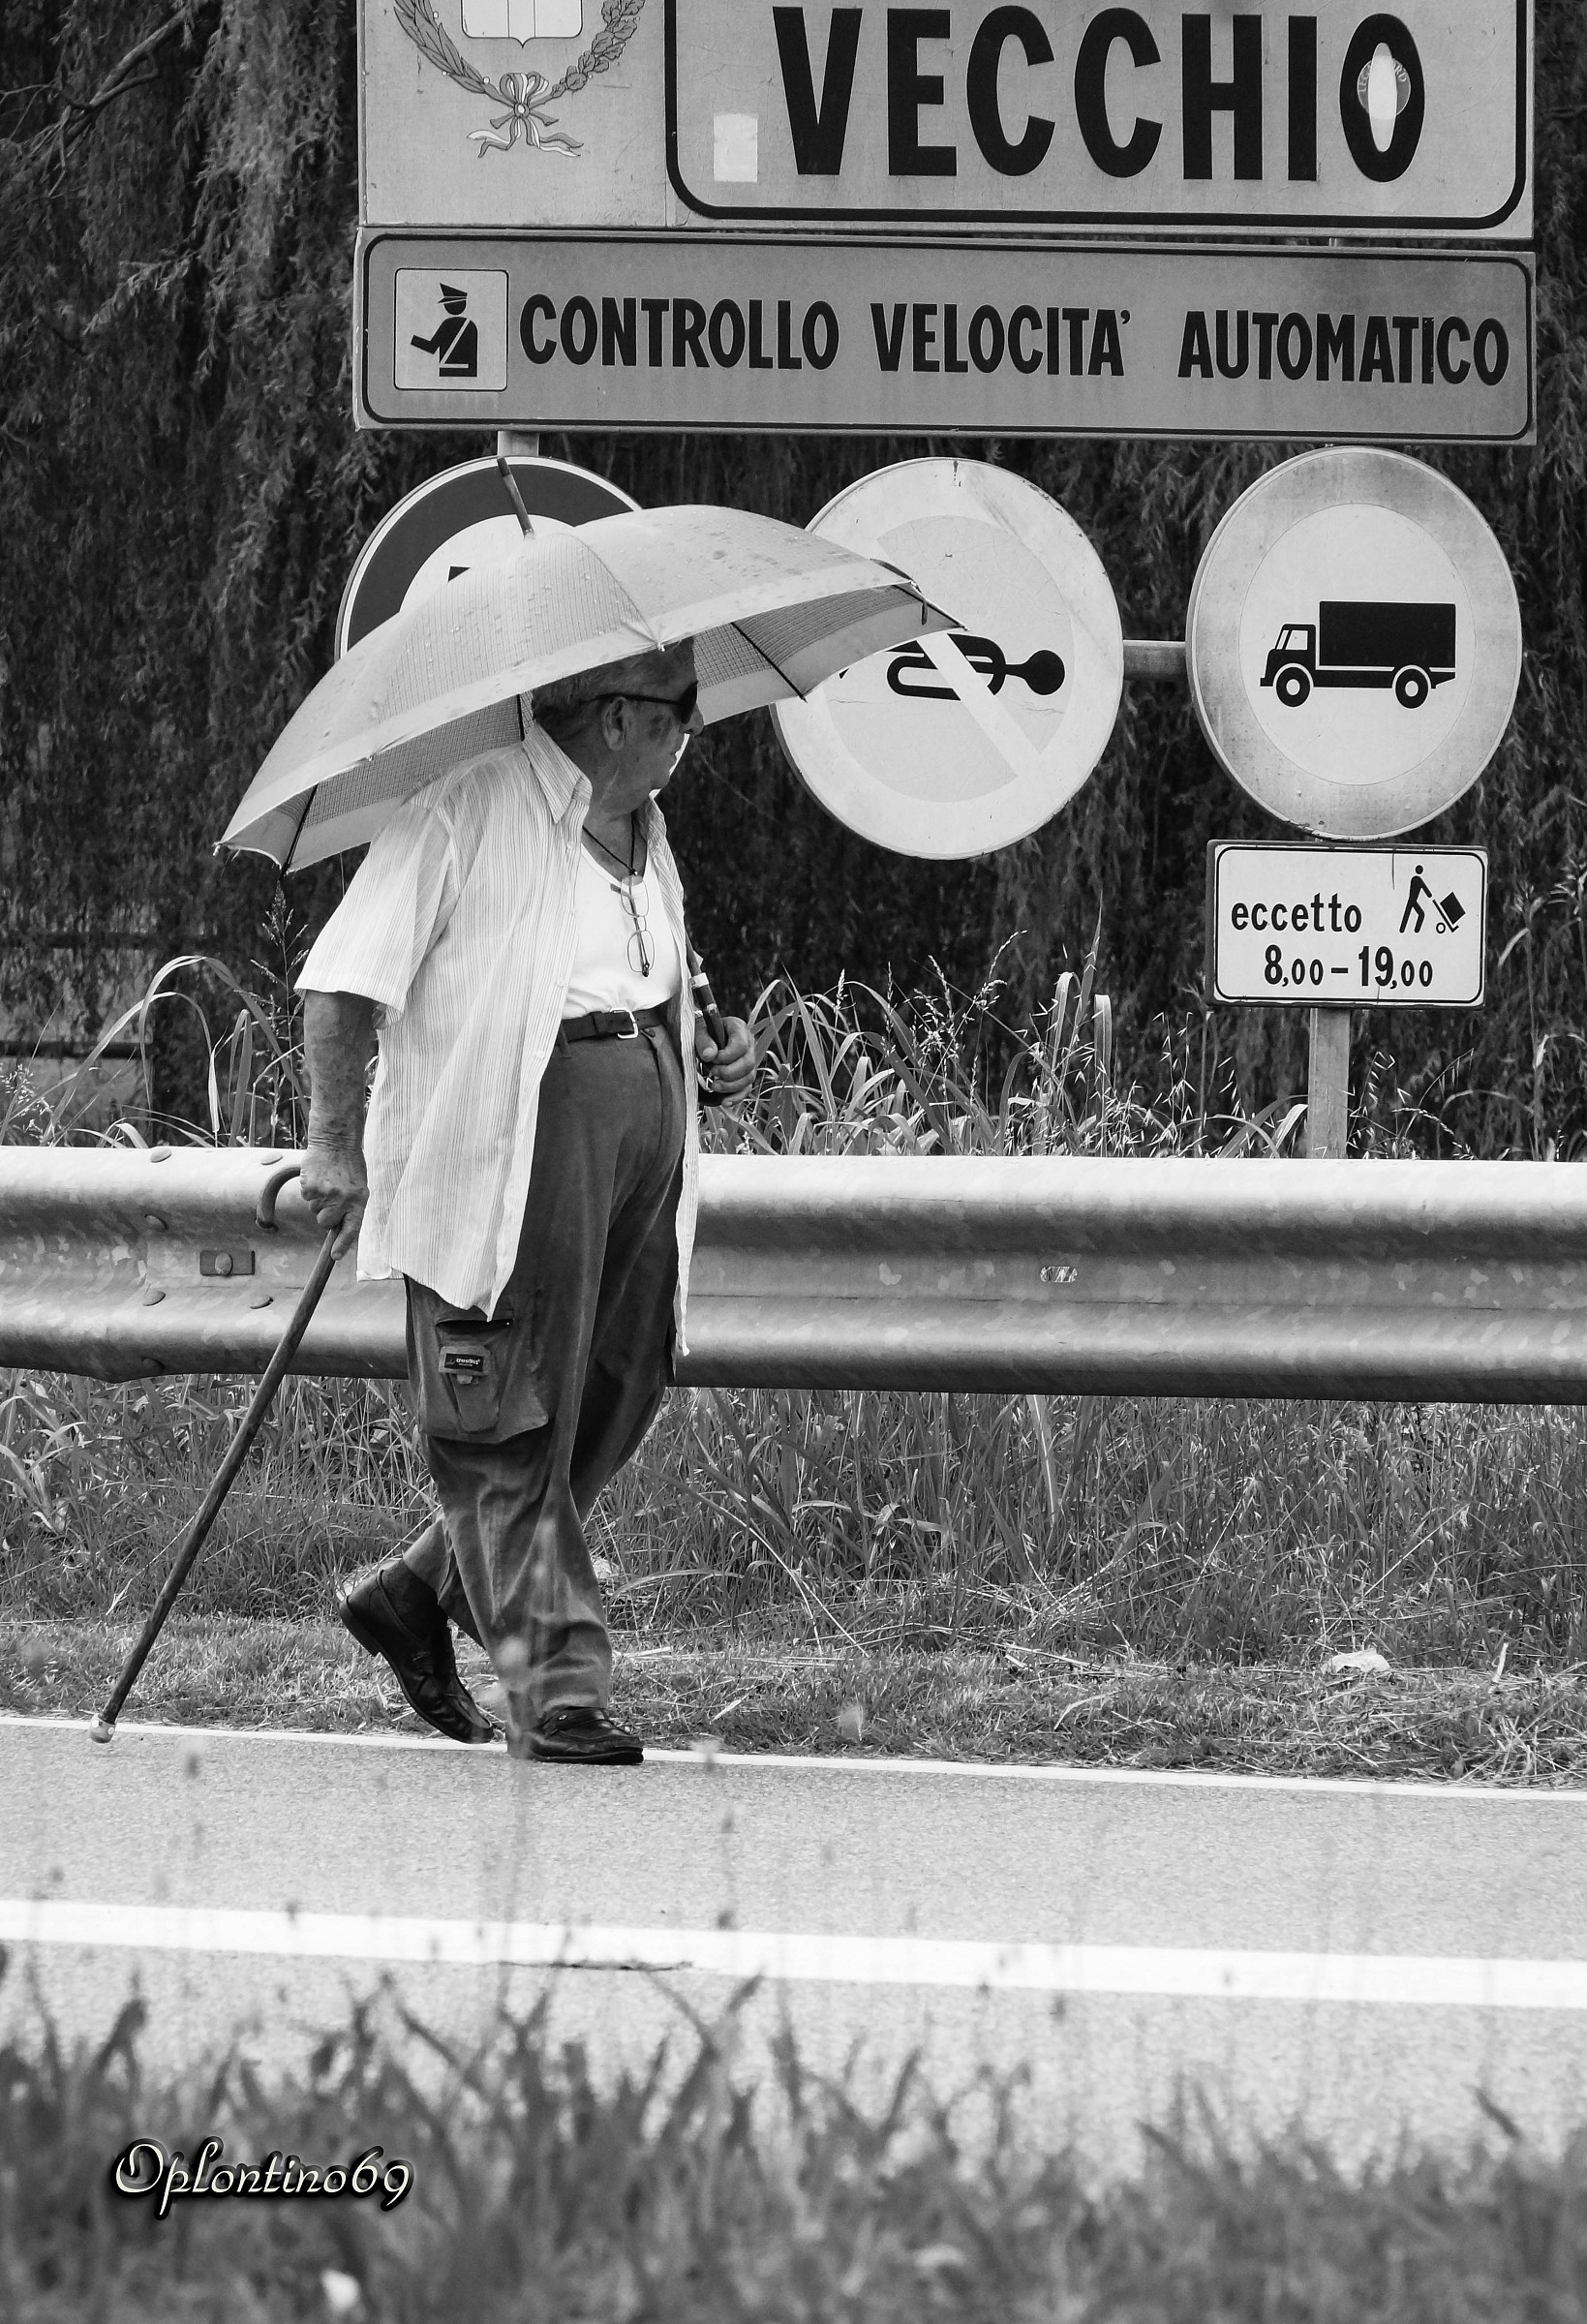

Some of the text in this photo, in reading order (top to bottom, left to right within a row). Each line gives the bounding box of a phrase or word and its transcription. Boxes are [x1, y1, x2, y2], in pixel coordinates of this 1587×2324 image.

[772, 5, 1425, 183] VECCHIO
[519, 293, 839, 370] CONTROLLO
[1177, 309, 1510, 385] AUTOMATICO
[1231, 892, 1362, 933] eccetto
